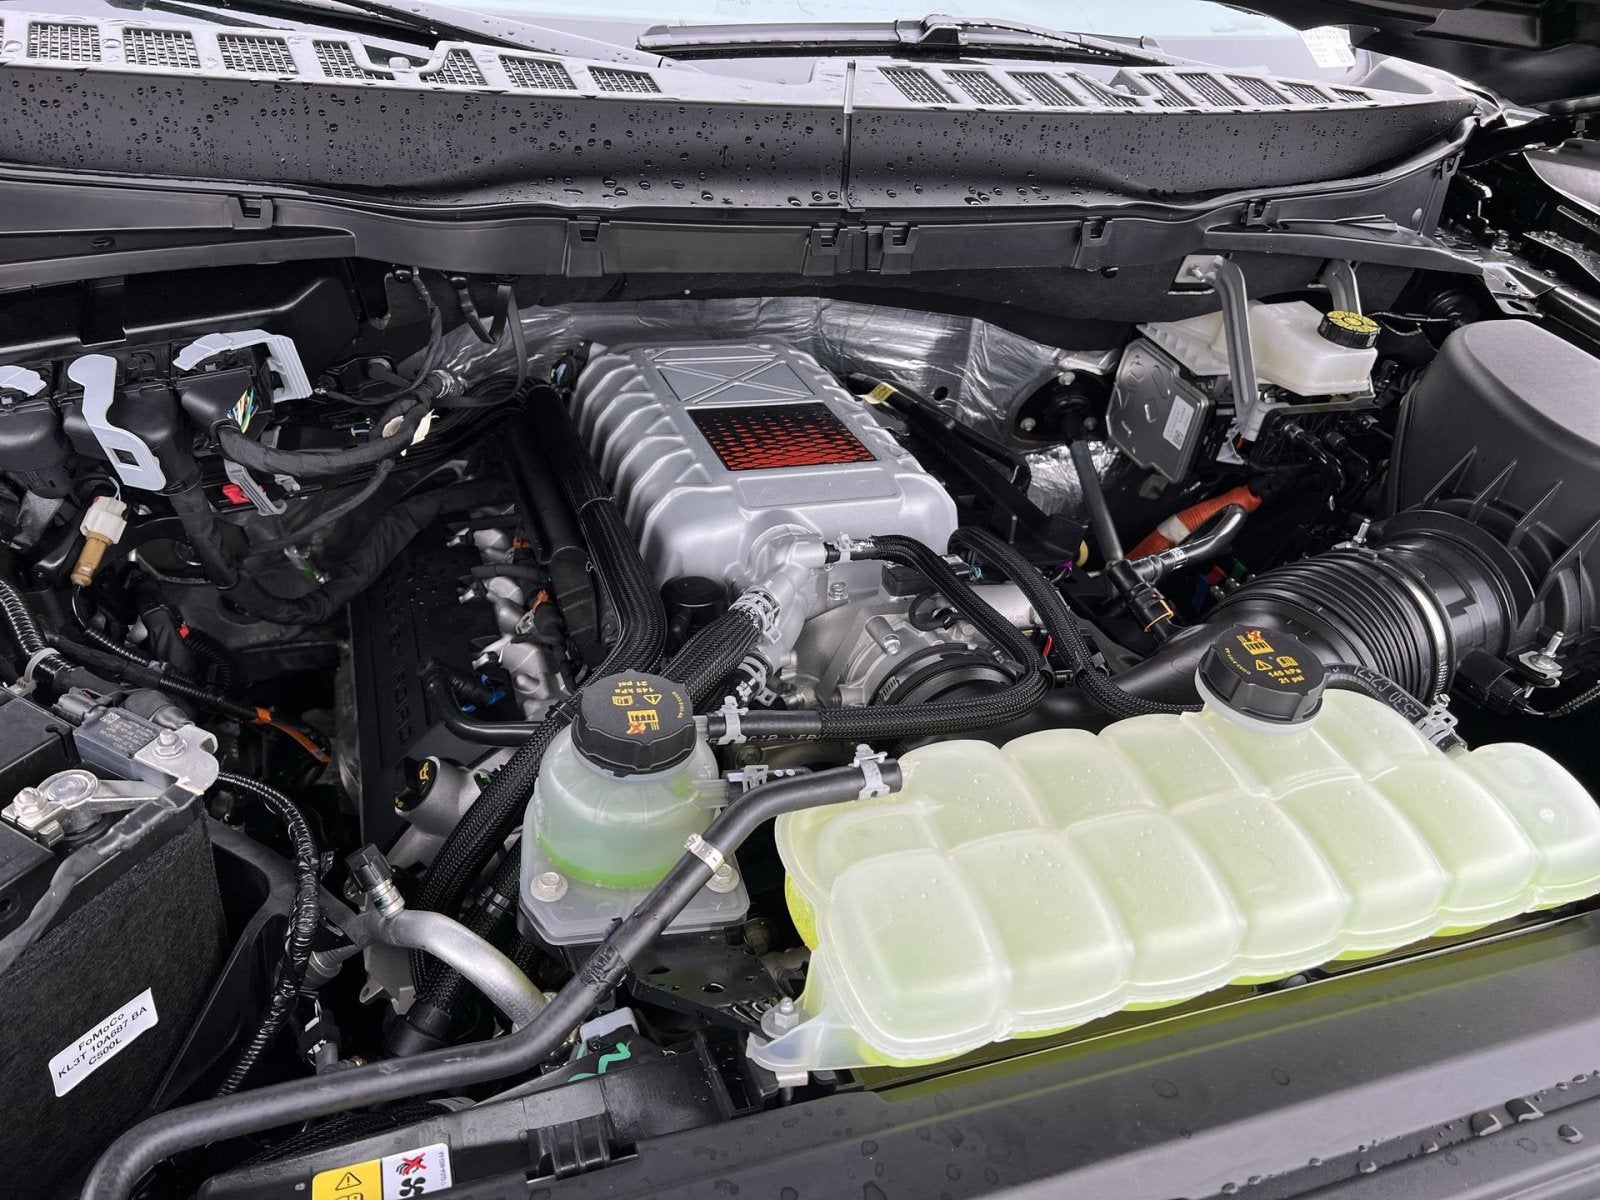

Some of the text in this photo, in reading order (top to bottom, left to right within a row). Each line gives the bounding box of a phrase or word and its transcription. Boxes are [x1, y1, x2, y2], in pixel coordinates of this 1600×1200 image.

[1268, 668, 1302, 678] 145 kPa
[1291, 675, 1305, 683] psi
[392, 665, 411, 745] FORD
[58, 1006, 148, 1078] KL3T 10A687 BA
[78, 1013, 125, 1051] FoMoCo
[88, 1039, 123, 1066] C500L
